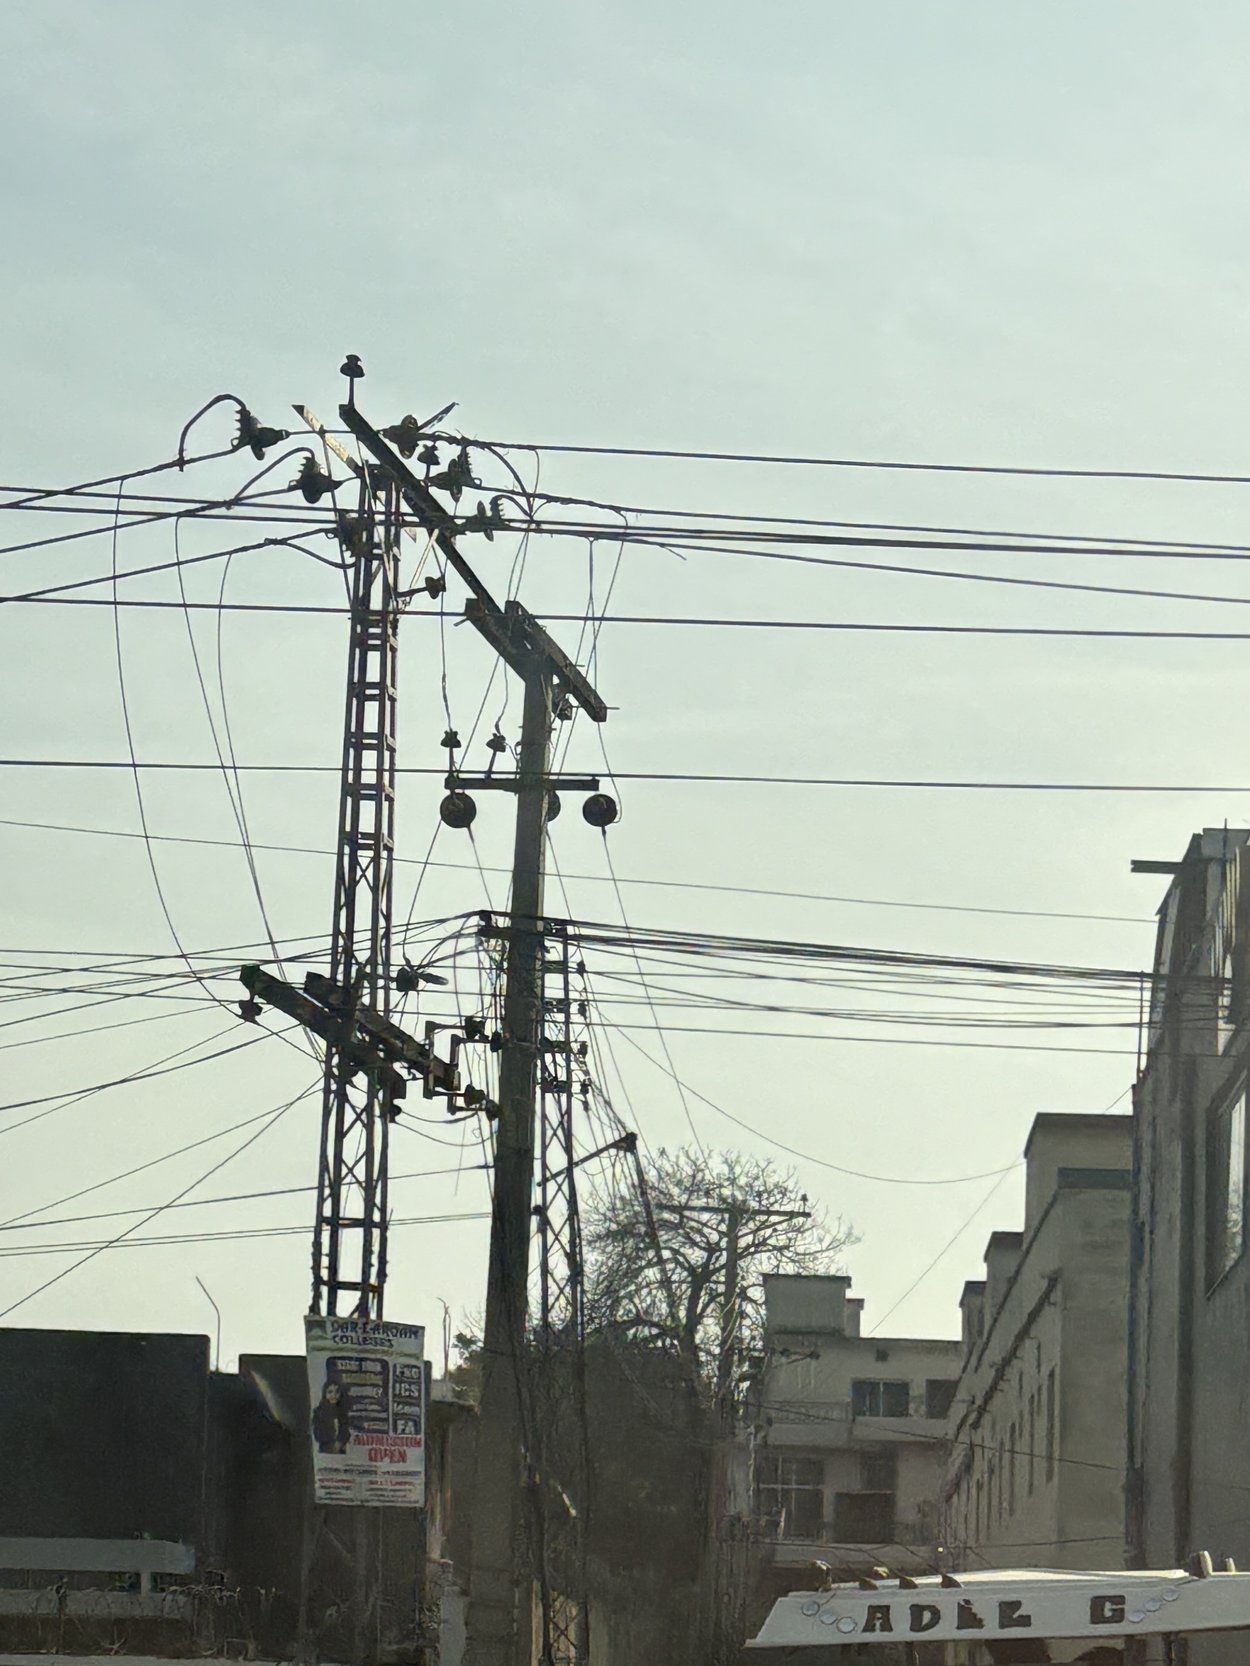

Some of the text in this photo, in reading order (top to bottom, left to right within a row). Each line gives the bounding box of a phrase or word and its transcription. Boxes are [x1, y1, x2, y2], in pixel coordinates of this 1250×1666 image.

[395, 1383, 419, 1398] ICS
[368, 1446, 408, 1464] OPEN
[1090, 1594, 1126, 1625] G
